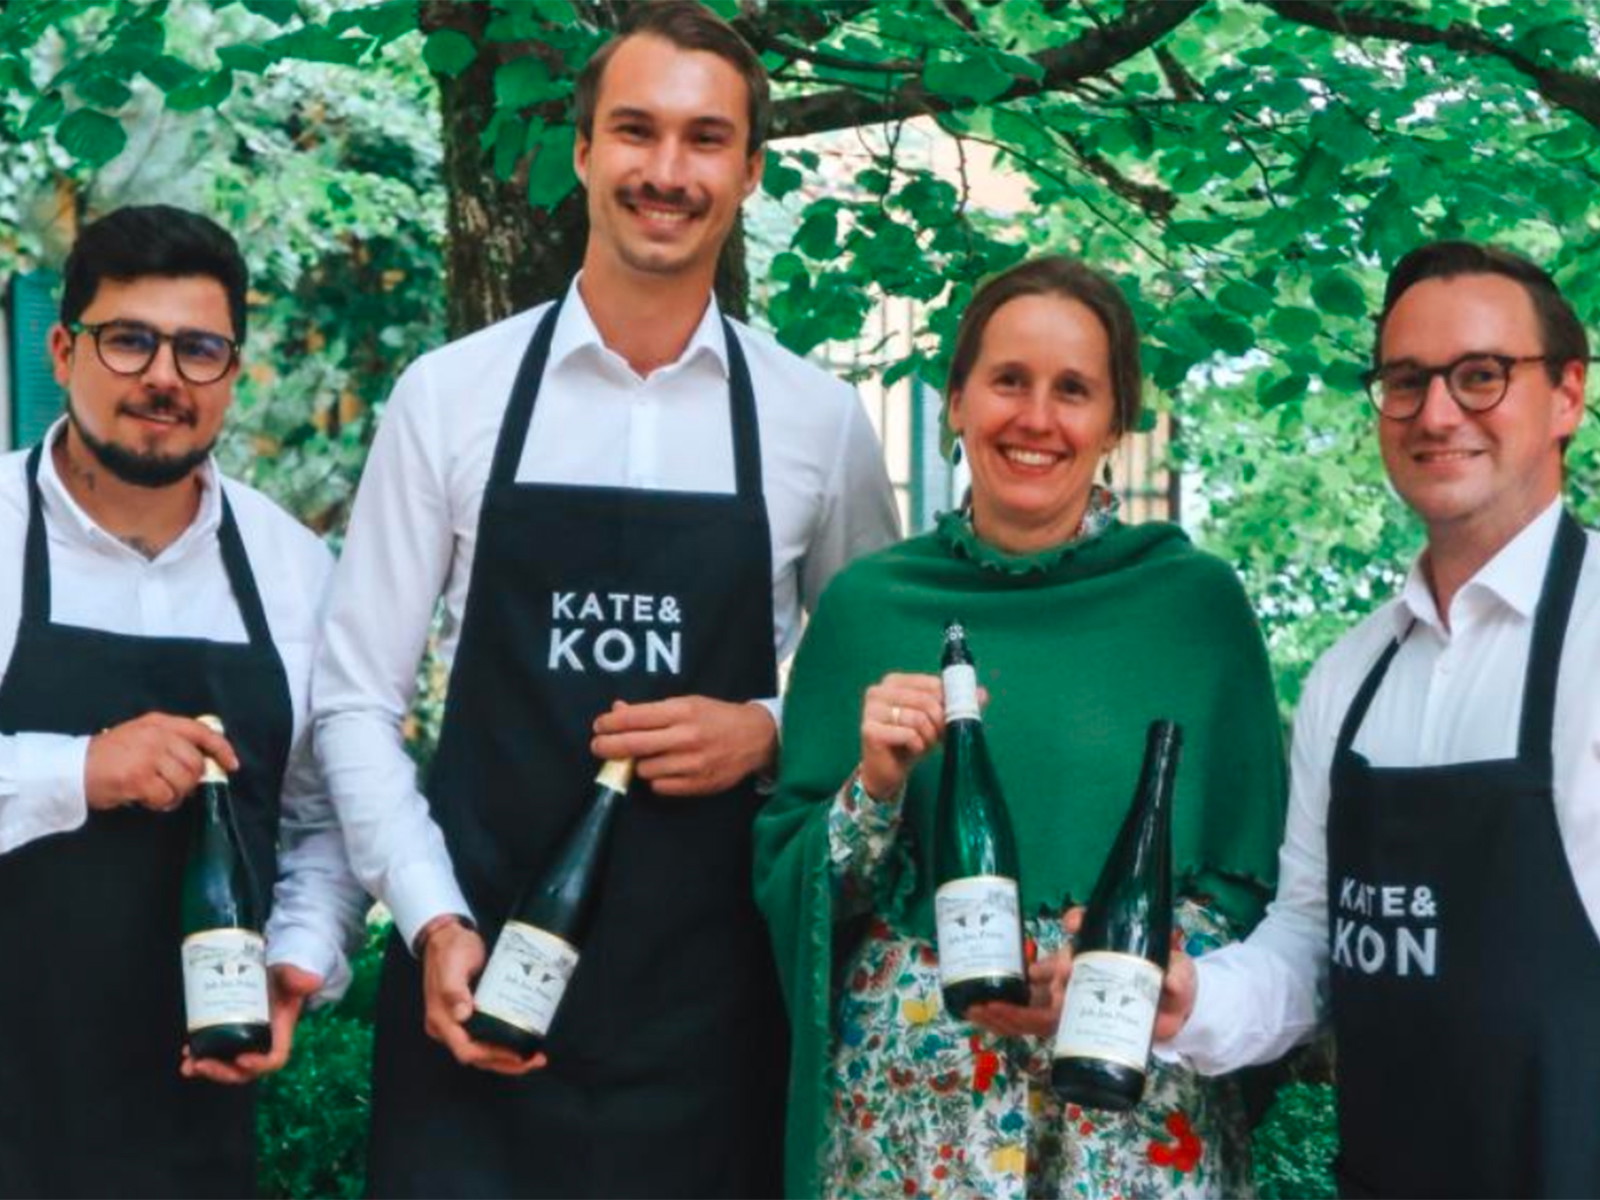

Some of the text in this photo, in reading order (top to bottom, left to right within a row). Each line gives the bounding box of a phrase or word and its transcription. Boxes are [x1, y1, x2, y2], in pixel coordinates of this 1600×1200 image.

[552, 592, 681, 623] KATE&
[548, 628, 681, 674] KON
[1332, 917, 1437, 976] KON
